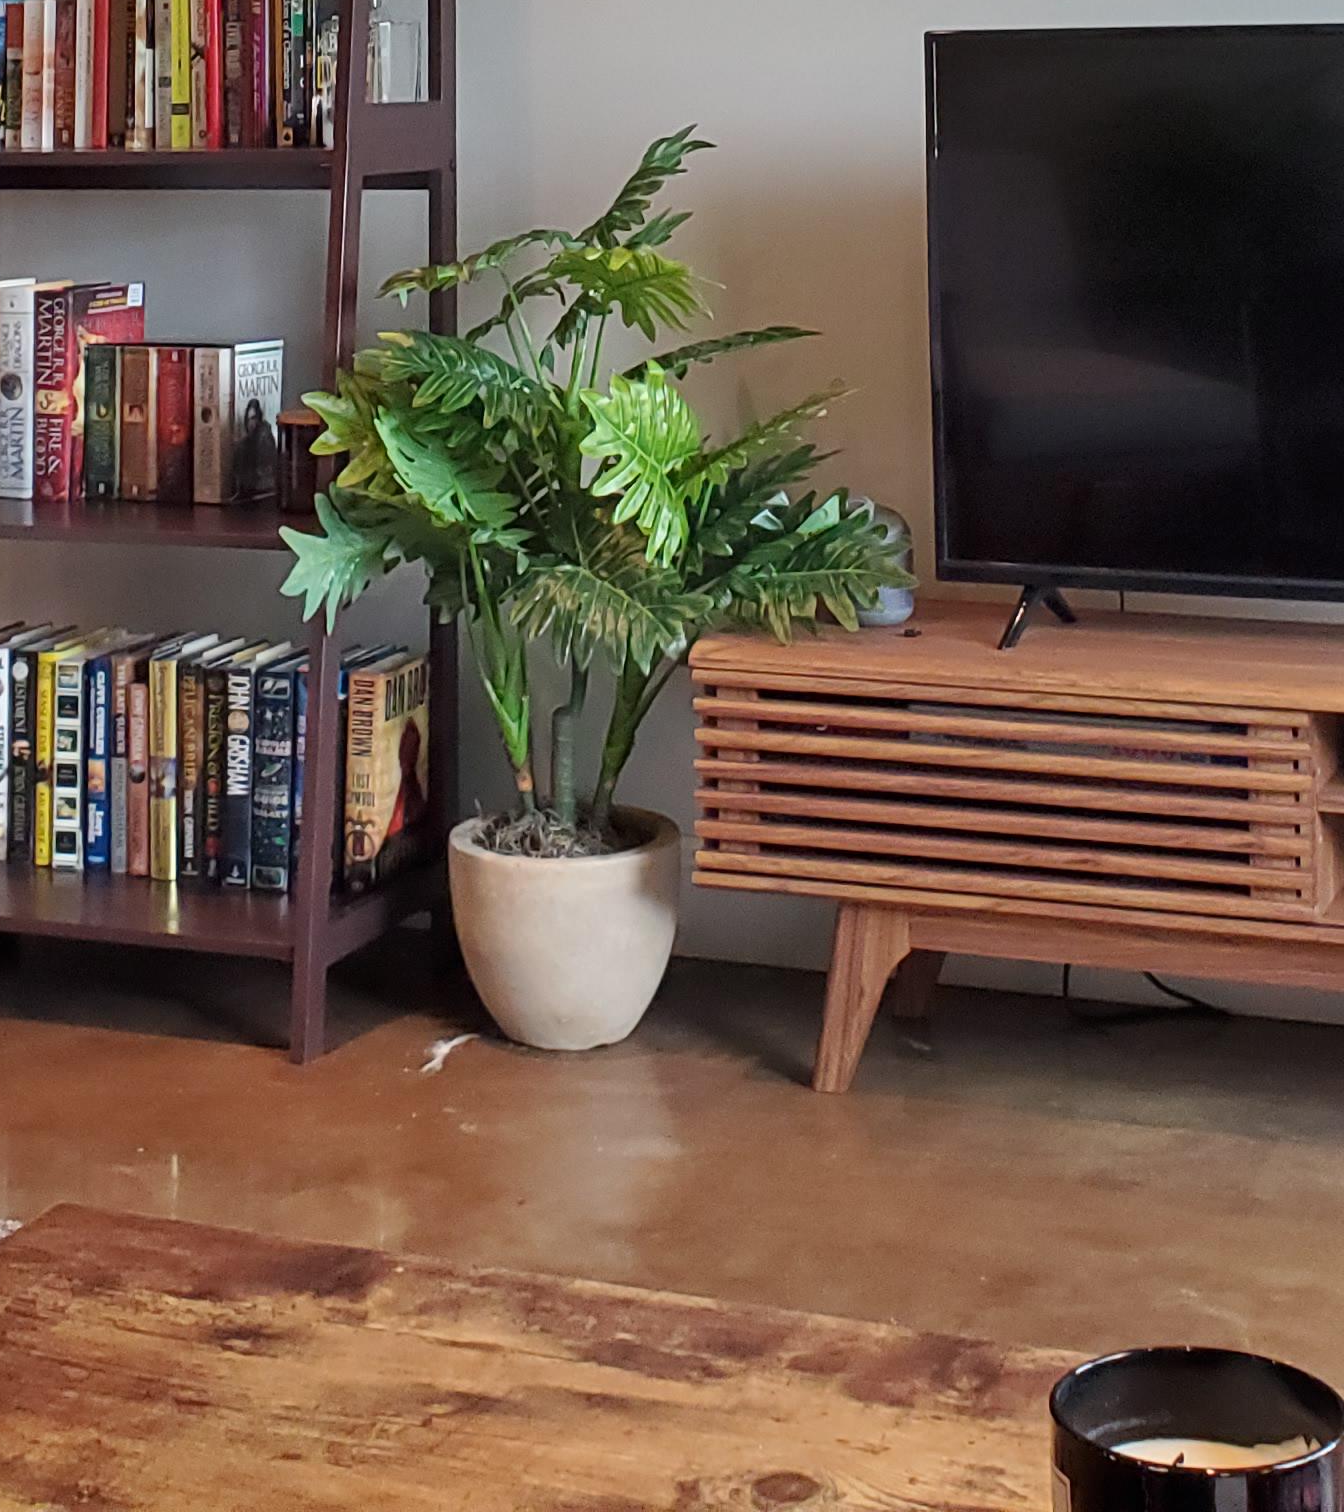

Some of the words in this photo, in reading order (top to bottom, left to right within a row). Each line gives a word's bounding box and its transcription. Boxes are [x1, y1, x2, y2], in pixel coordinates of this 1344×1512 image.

[36, 297, 53, 387] MARTIN
[52, 297, 66, 353] GEORGE
[238, 372, 279, 398] MARTIN
[10, 407, 25, 481] MARTIN
[47, 417, 64, 450] FIRE
[183, 674, 197, 741] PELICAN
[227, 672, 250, 711] JOHN
[353, 679, 375, 706] DAN
[207, 694, 224, 759] PRESTON
[351, 710, 374, 757] BROWN
[183, 742, 197, 783] BRIEF
[226, 734, 250, 796] GRISHAM
[351, 773, 370, 790] LOST
